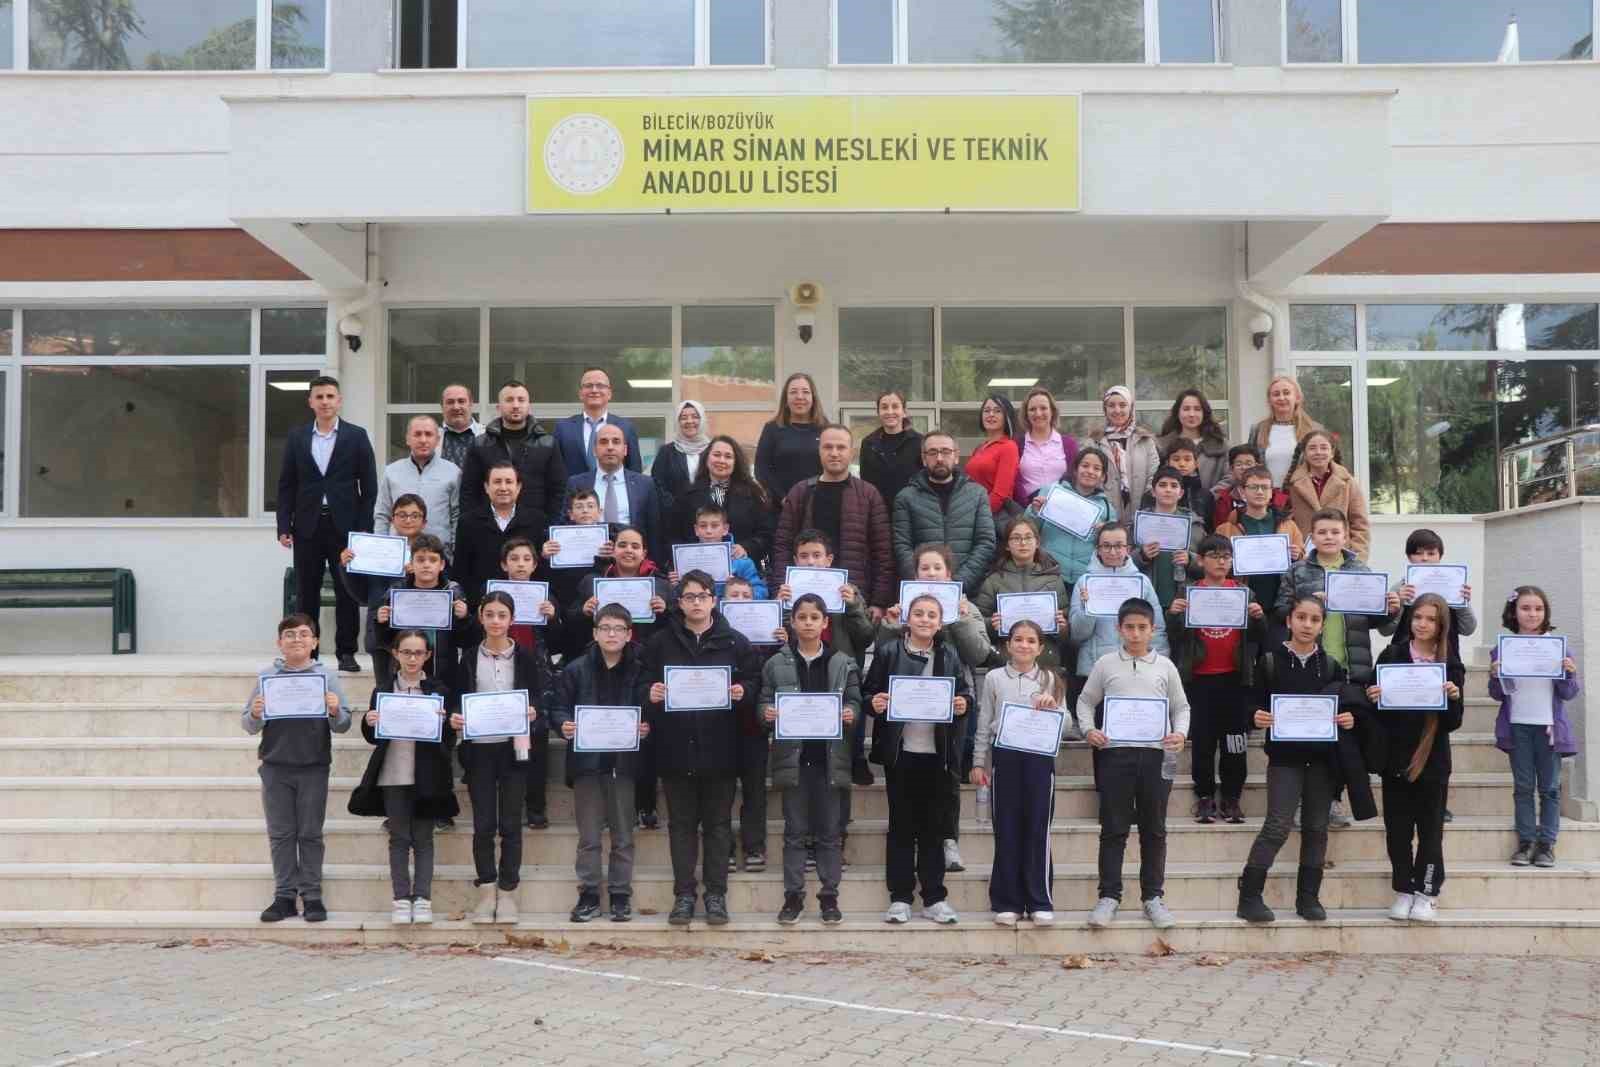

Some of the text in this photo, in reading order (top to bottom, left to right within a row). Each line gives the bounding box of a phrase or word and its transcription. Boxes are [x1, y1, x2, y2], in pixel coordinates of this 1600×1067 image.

[643, 112, 774, 131] BİLECİK/BOZÜYÜK
[643, 133, 1049, 162] MİMAR SİNAN MESLEKİ VE TEKNİK
[642, 166, 838, 195] ANADOLU LİSESİ
